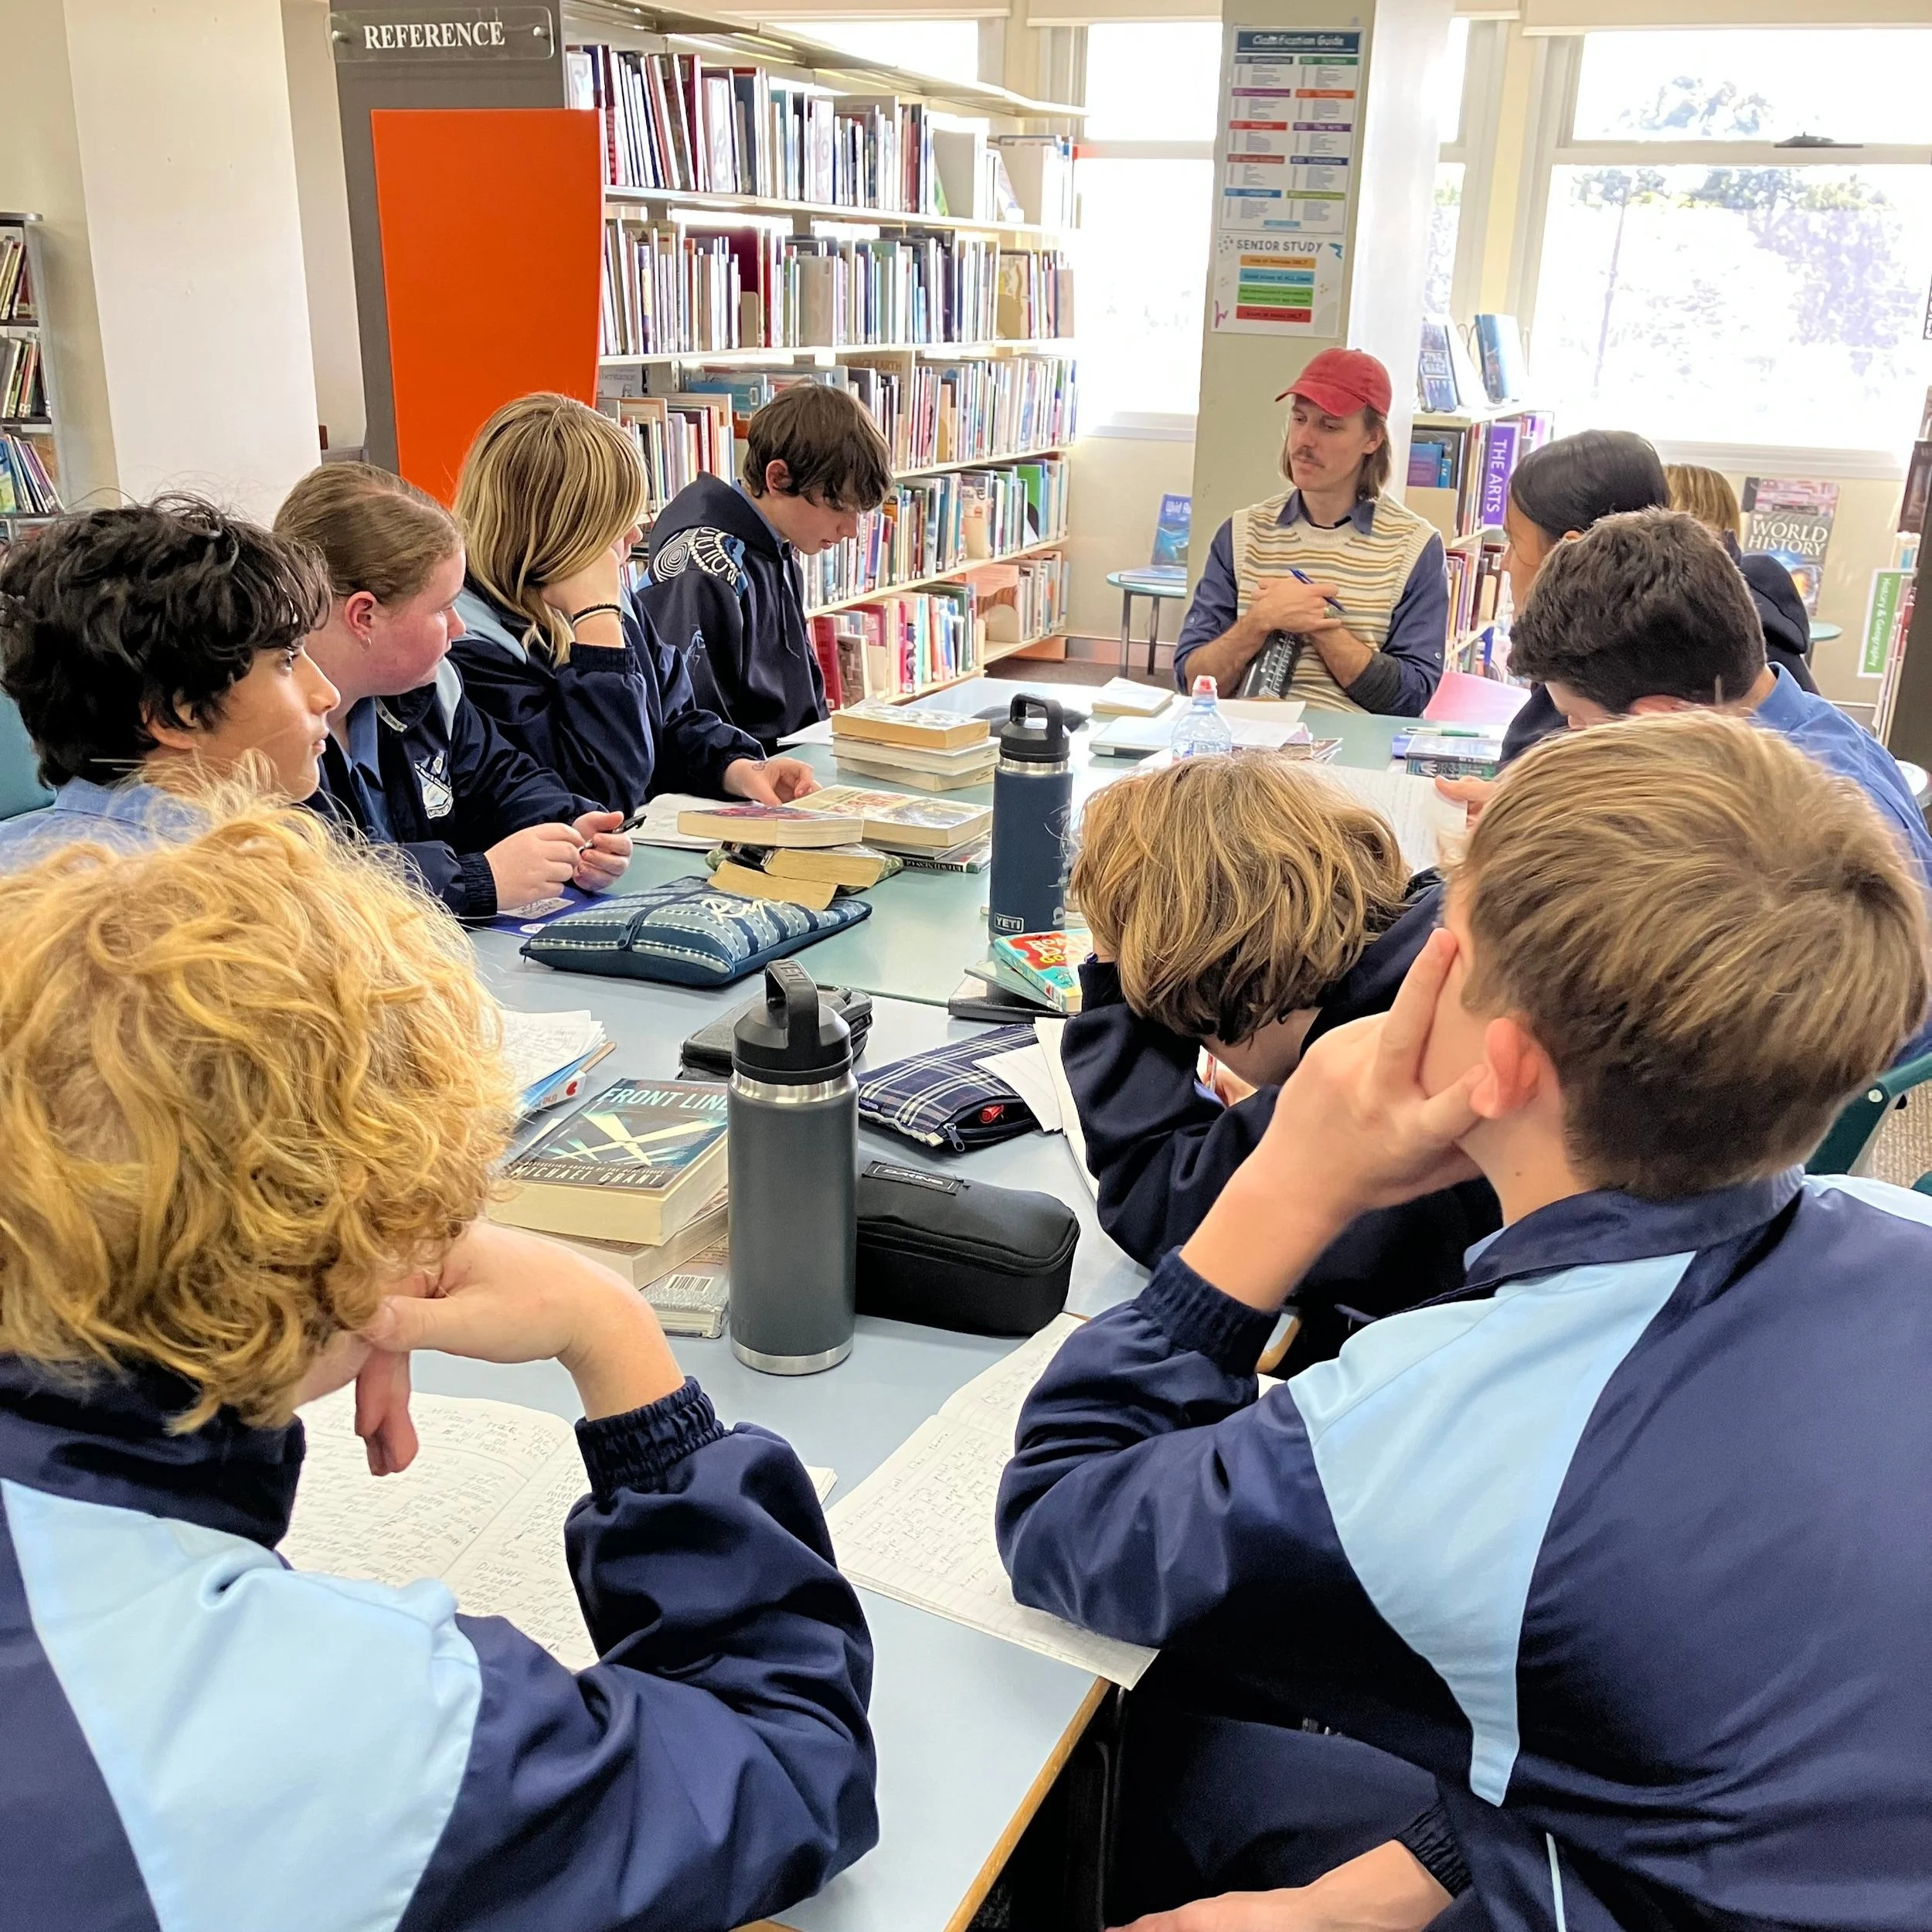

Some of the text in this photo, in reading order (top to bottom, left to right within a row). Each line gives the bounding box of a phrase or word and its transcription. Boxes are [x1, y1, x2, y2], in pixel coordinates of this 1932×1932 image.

[363, 21, 505, 49] REFERENCE
[1236, 240, 1323, 253] SENIOR STUDY
[1486, 439, 1508, 513] THE ARTS
[1752, 519, 1828, 543] WORLD
[1747, 535, 1826, 556] HISTORY
[1876, 577, 1893, 608] History
[1868, 618, 1886, 667] Geography
[995, 916, 1021, 930] YETI
[596, 1087, 685, 1107] FRONT
[510, 1165, 663, 1185] MICHAEL GRANT
